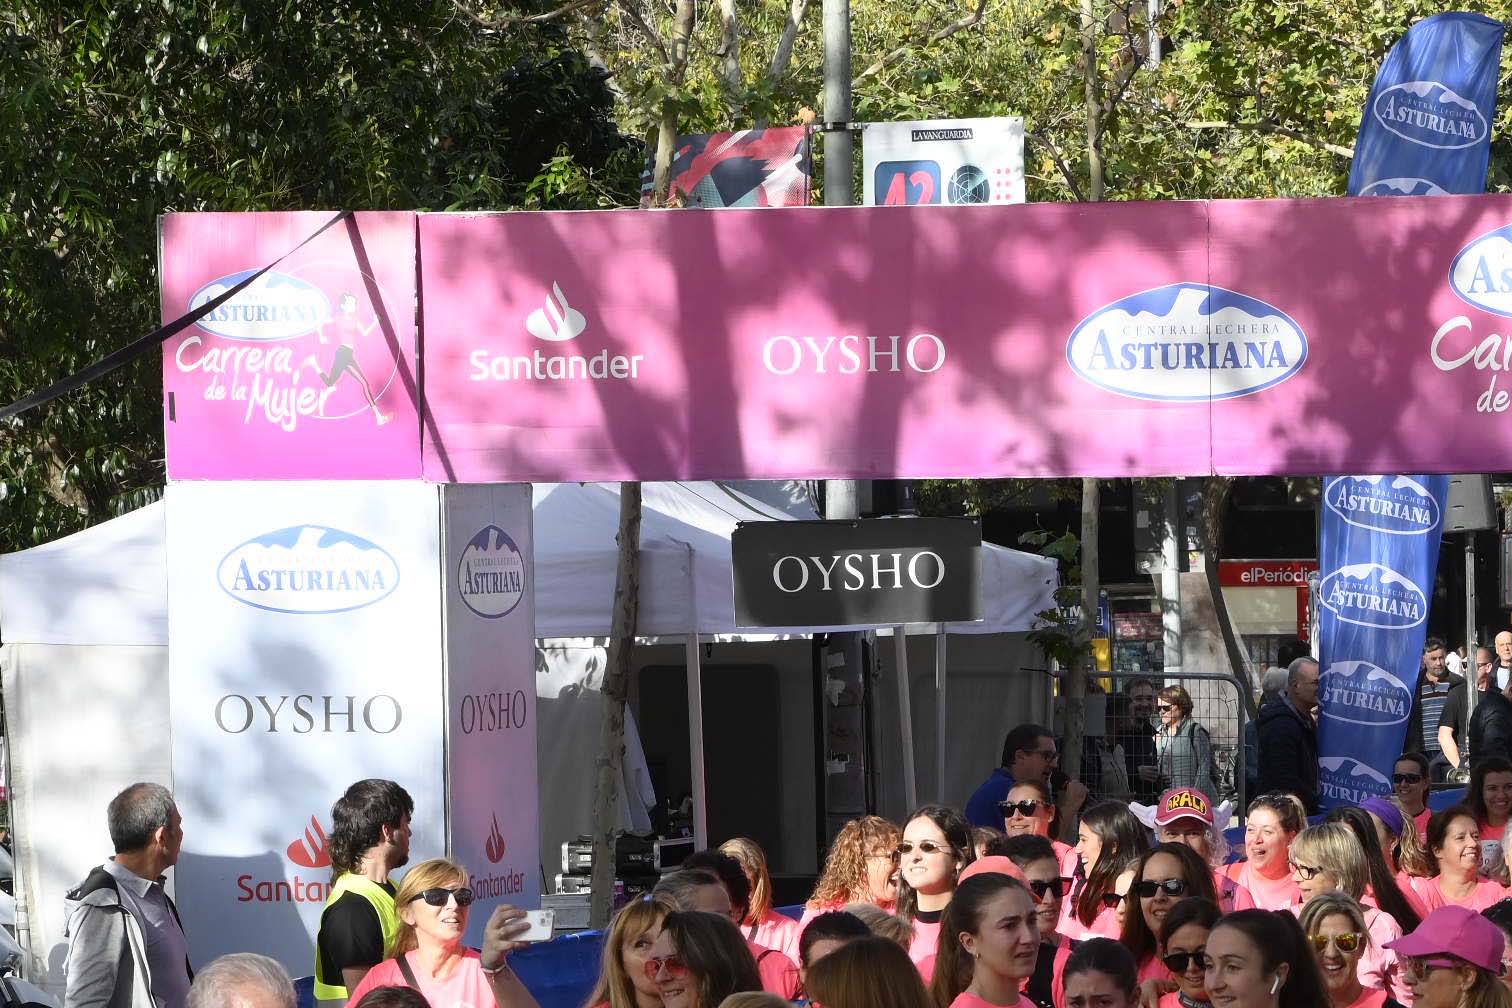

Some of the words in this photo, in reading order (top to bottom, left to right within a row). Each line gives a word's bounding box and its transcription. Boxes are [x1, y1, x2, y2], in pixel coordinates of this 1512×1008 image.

[1382, 96, 1476, 139] ASTURIANA
[199, 295, 323, 323] ASTURIANA
[1123, 323, 1196, 337] CENTRAL
[1206, 322, 1281, 335] LECHERA
[175, 336, 293, 373] Carrera
[469, 349, 645, 381] Santander
[763, 333, 947, 375] OYSHO
[1086, 336, 1289, 372] ASTURIANA
[204, 378, 226, 401] de
[231, 377, 246, 401] la
[244, 370, 337, 432] Mujer
[1477, 374, 1511, 414] de
[1336, 484, 1431, 526] ASTURIANA
[232, 557, 386, 592] ASTURIANA
[464, 559, 522, 595] ASTURIANA
[772, 551, 946, 593] OYSHO
[1241, 566, 1313, 585] elPeriódi
[1327, 579, 1420, 620] ASTURIANA
[214, 694, 403, 734] OYSHO
[460, 689, 527, 735] OYSHO
[1322, 685, 1405, 716] STURIANA
[238, 875, 331, 903] Santa
[469, 867, 525, 900] Santander
